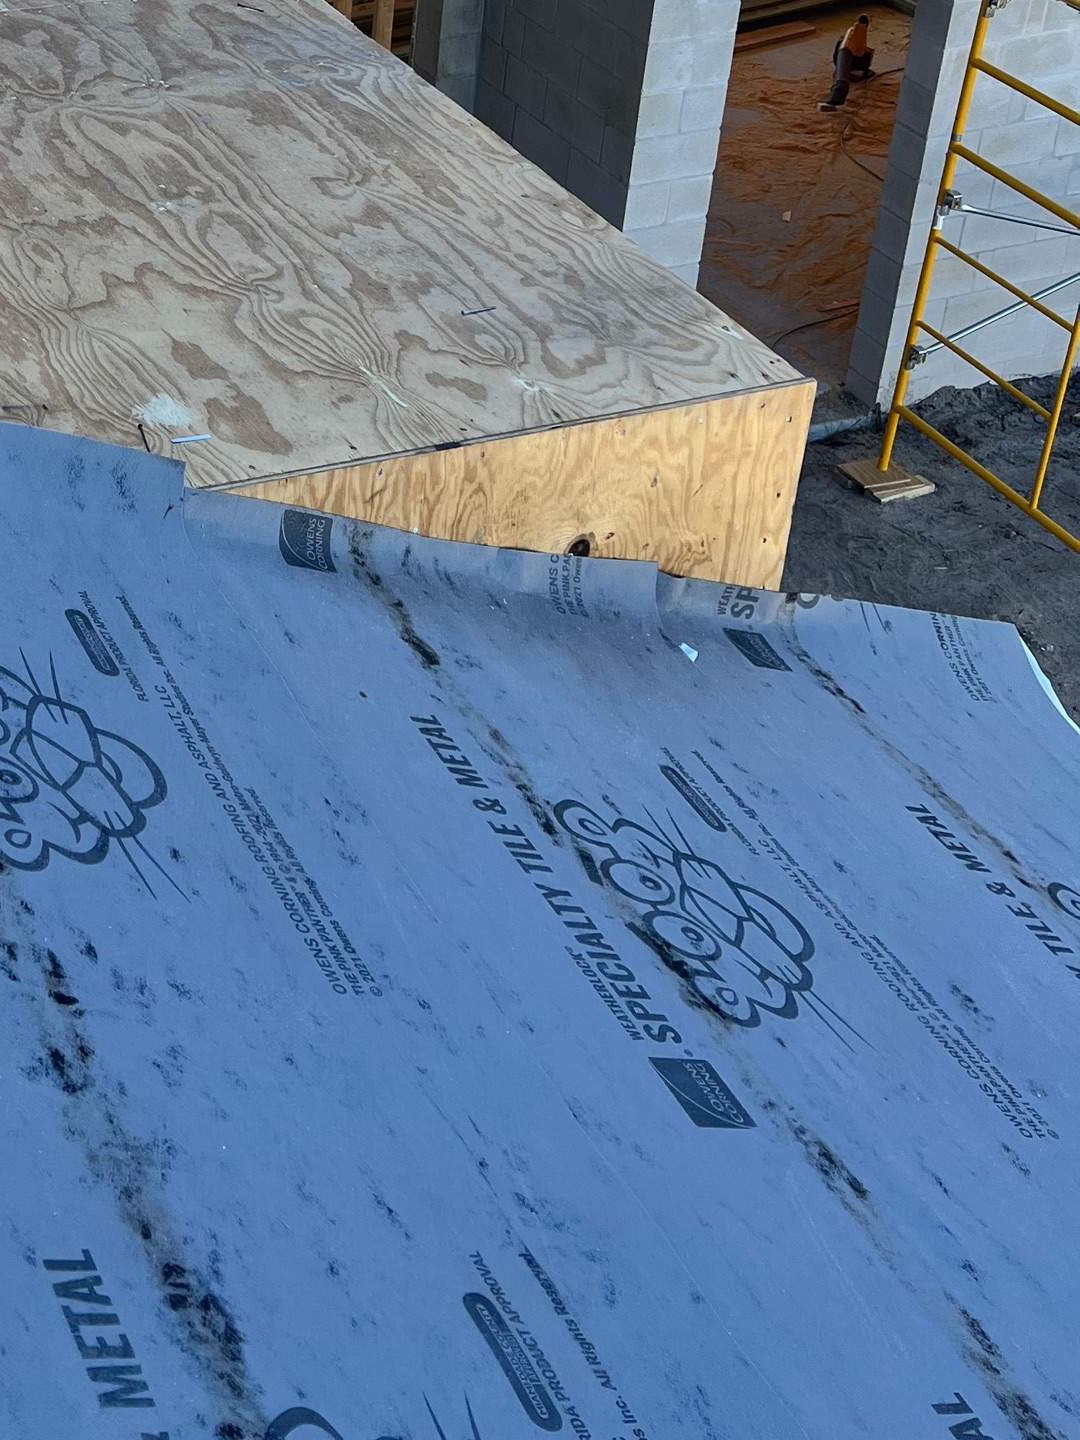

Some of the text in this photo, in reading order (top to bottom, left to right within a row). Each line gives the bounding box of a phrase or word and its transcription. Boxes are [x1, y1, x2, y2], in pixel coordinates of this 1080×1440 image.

[306, 518, 317, 560] OWENS
[315, 520, 328, 570] CORNING
[548, 567, 566, 615] OWENS
[561, 572, 571, 598] PINK
[78, 590, 110, 629] APPROVAL
[99, 625, 129, 665] PRODUCT
[140, 631, 161, 657] Rights
[123, 666, 149, 703] FLORIDA
[172, 685, 194, 717] Studios
[949, 663, 980, 702] OWENS
[189, 717, 253, 812] Metro-Goldwyn-Mayer
[154, 684, 348, 996] OWENS CORNING ROOFING AND ASPHALT, LLC
[273, 831, 299, 860] Rights
[727, 821, 761, 856] FLORIDA
[410, 714, 683, 1045] SPECIALTY TILE & METAL
[904, 803, 1074, 956] TILE & METAL
[329, 919, 358, 955] Owens
[326, 944, 351, 972] PINK
[350, 957, 377, 984] 2021
[342, 972, 366, 996] THE
[369, 986, 383, 998] ©
[758, 839, 1033, 1139] OWENS CORNING ROOFING AND ASPHALT, LLC
[910, 977, 939, 1007] Rights
[683, 1062, 723, 1111] OWENS
[698, 1063, 745, 1124] CORNING
[990, 1065, 1022, 1100] Owens
[999, 1088, 1027, 1115] PINK
[1021, 1101, 1050, 1127] 2021
[1023, 1116, 1047, 1139] THE
[1047, 1128, 1060, 1141] ©
[42, 1248, 156, 1409] METAL
[469, 1250, 571, 1402] PRODUCT APPROVAL
[518, 1245, 639, 1425] Inc. All Rights Reserved.
